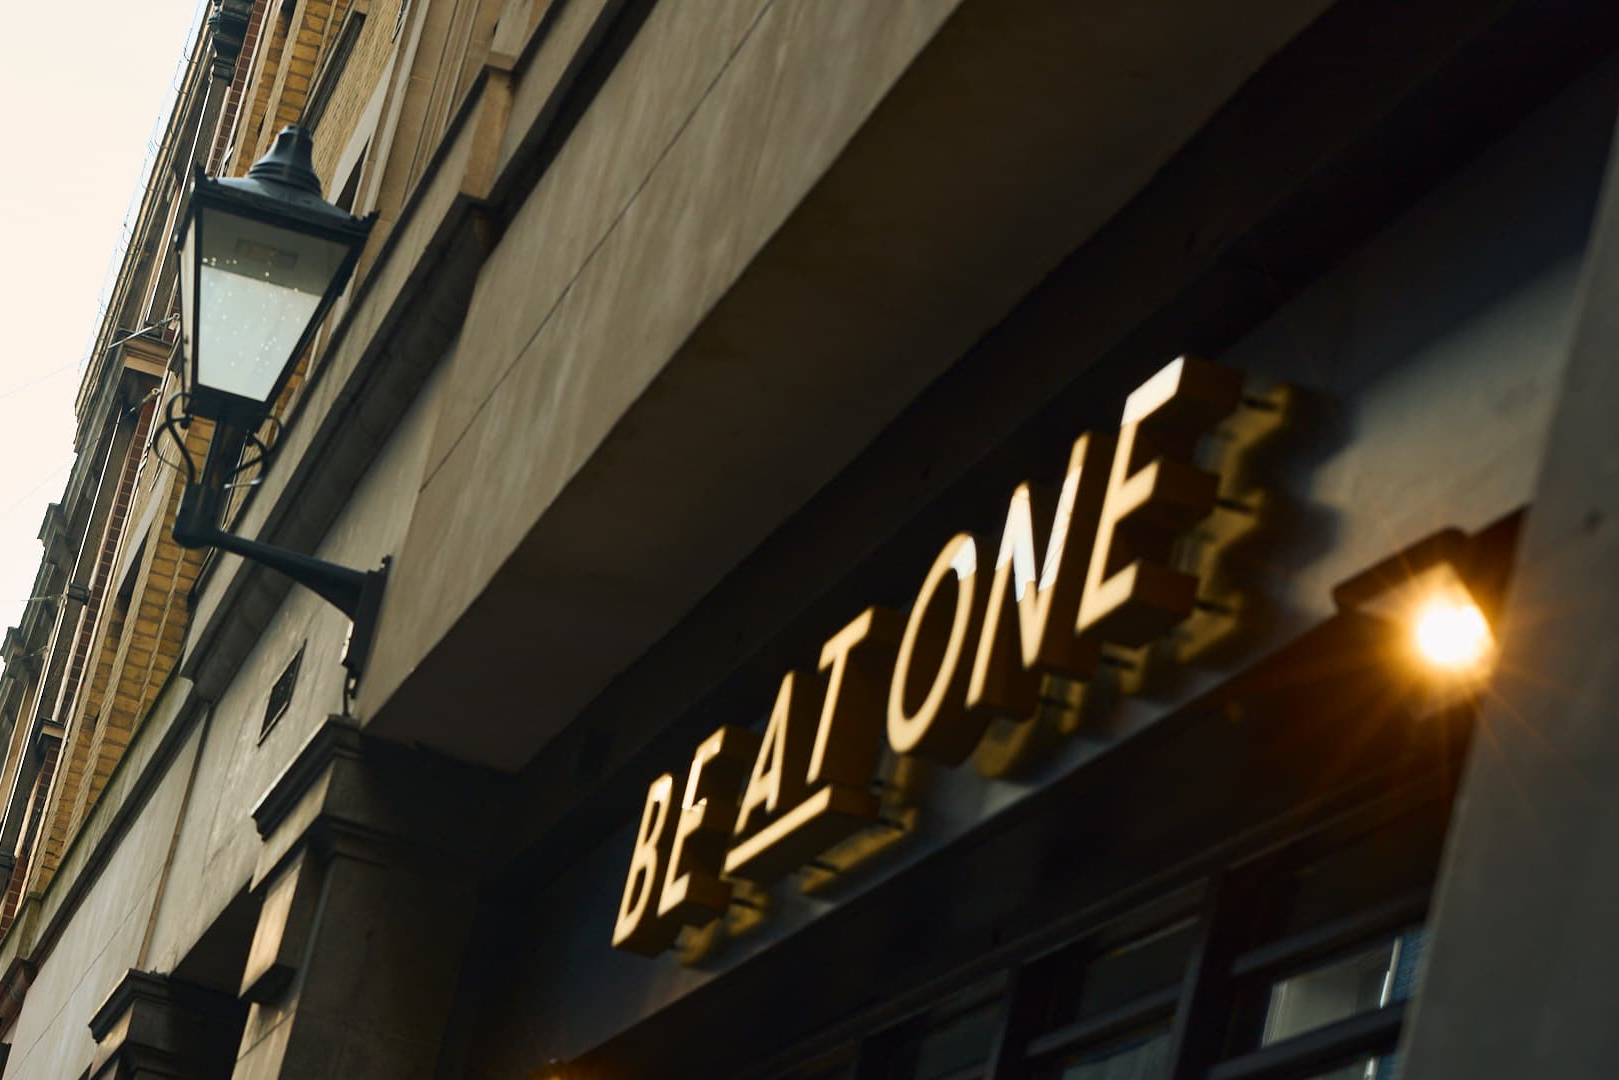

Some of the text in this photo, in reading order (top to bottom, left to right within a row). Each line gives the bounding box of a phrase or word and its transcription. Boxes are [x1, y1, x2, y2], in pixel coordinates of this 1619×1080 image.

[612, 357, 1185, 950] BE AT ONE
